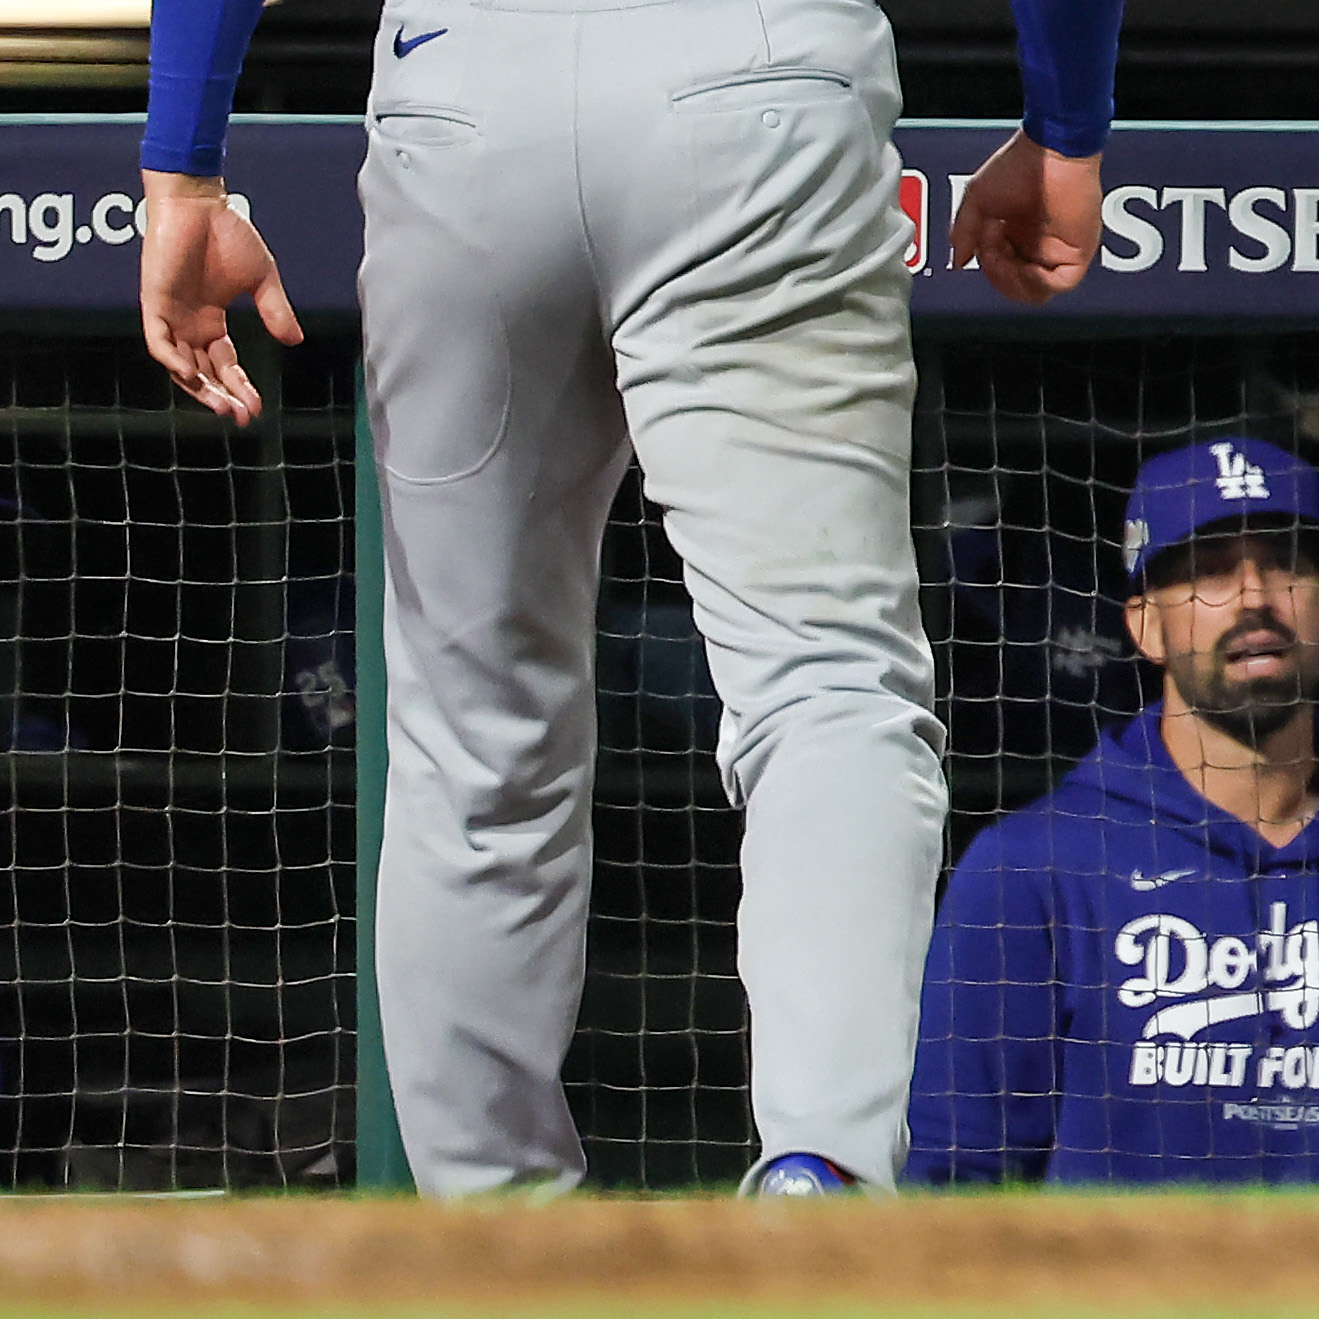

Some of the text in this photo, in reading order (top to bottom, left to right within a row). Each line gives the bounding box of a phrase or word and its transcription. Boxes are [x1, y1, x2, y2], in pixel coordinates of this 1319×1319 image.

[0, 193, 250, 262] ng.c
[1209, 442, 1271, 499] LA
[1129, 1041, 1252, 1087] BUILT
